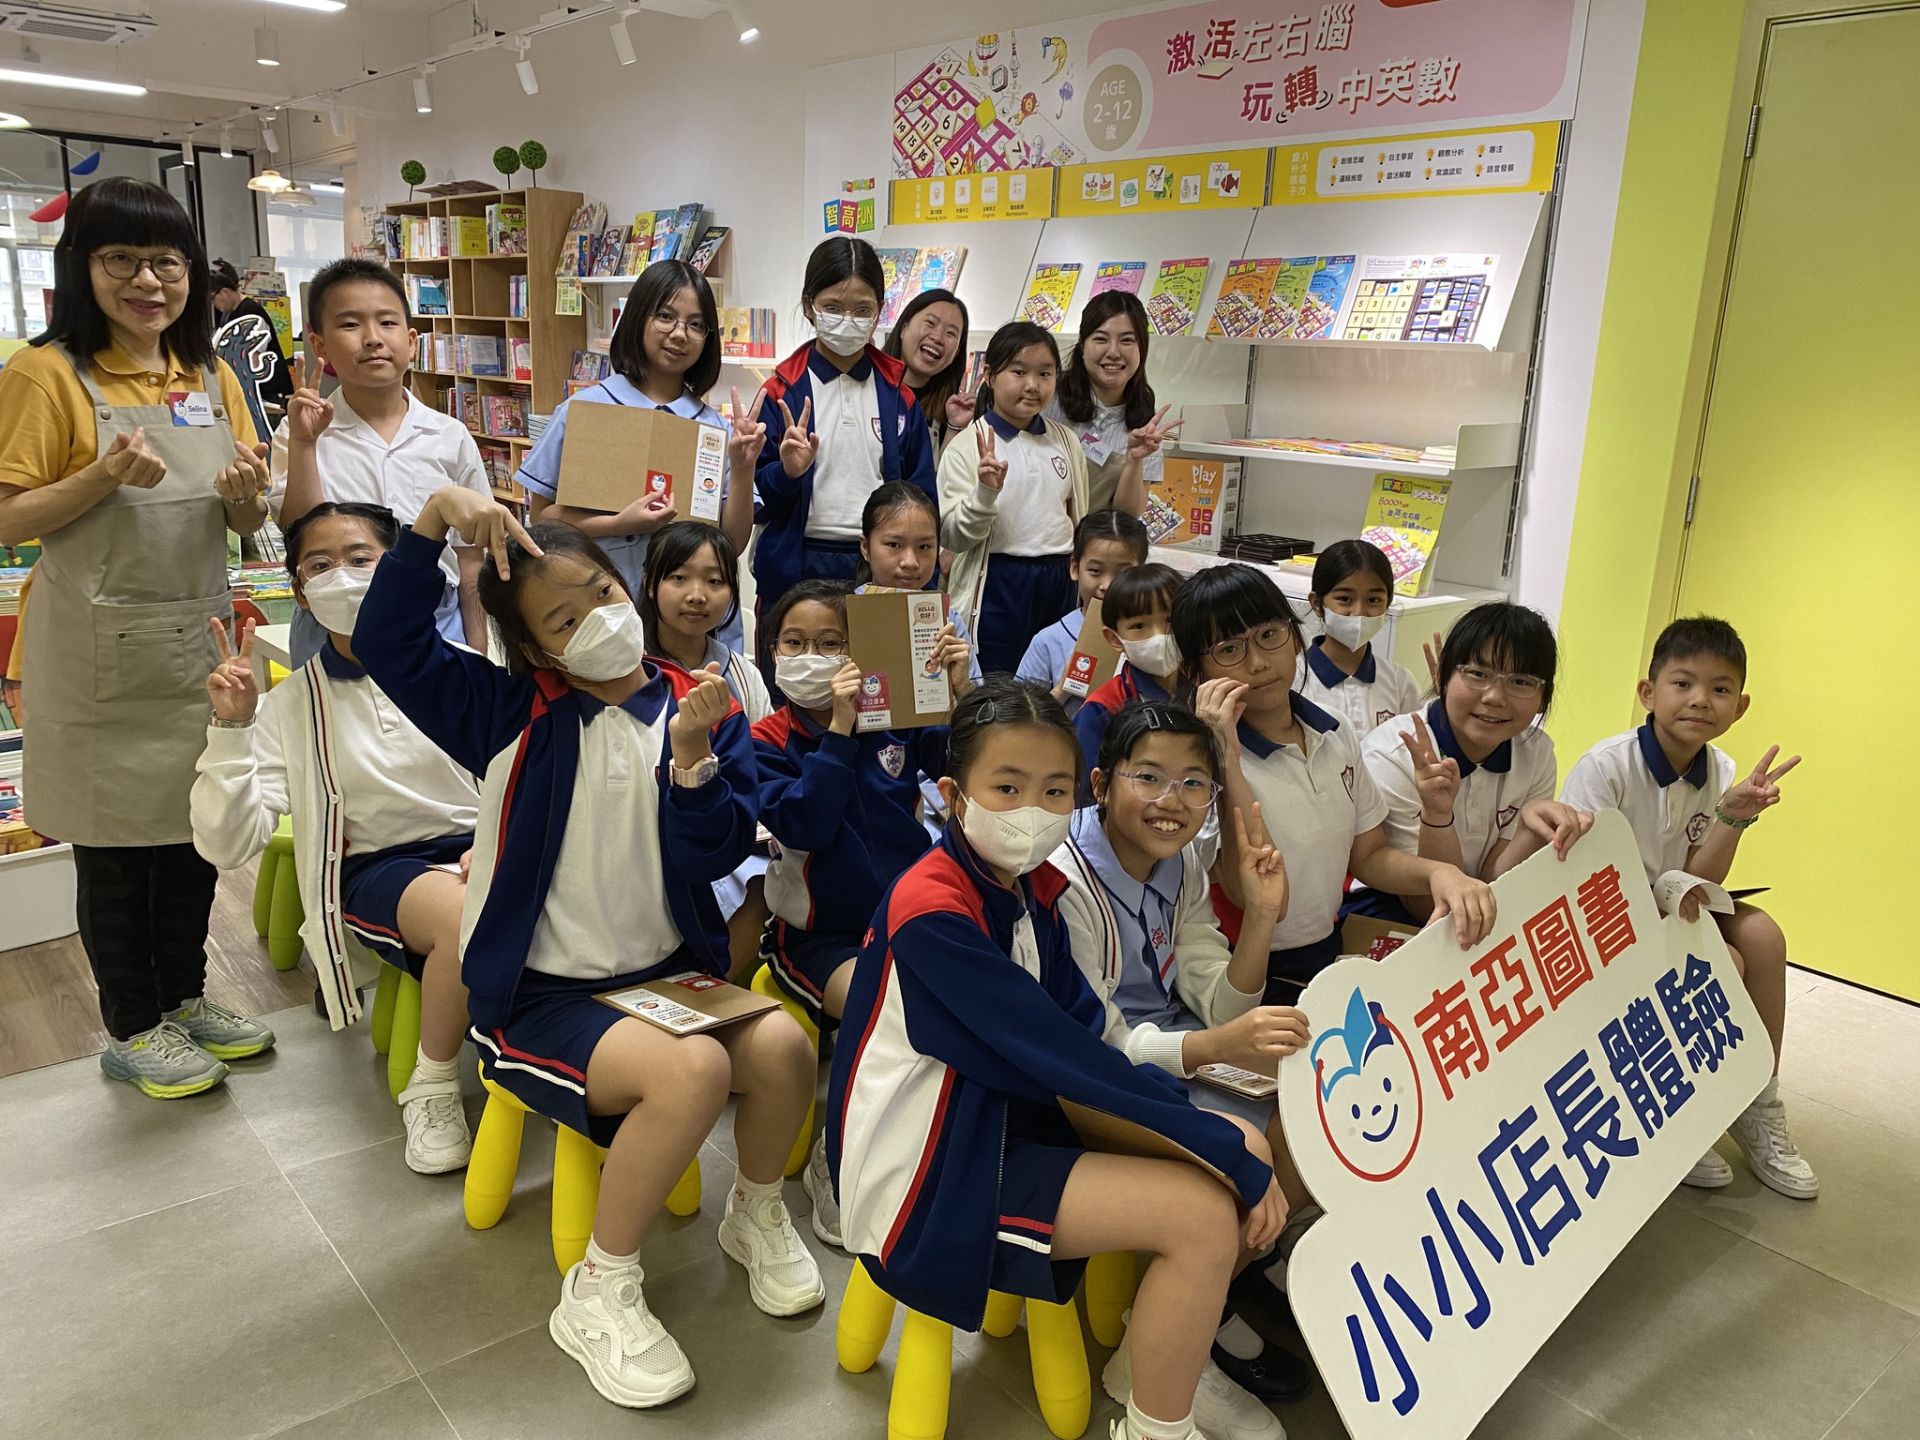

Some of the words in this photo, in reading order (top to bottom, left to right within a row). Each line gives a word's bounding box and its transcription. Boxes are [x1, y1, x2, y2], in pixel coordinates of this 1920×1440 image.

[1166, 3, 1355, 75] 激活左右腦
[1100, 80, 1126, 97] AGE
[1240, 56, 1462, 123] 玩轉中英數
[1093, 99, 1132, 123] 2-12
[896, 121, 906, 133] 14
[921, 119, 930, 132] 11
[942, 115, 951, 130] 6
[907, 134, 918, 147] 15
[932, 136, 941, 147] 12
[918, 148, 928, 162] 16
[1012, 144, 1022, 154] 7
[950, 157, 959, 170] 2
[187, 405, 207, 413] Selina
[1192, 464, 1217, 485] Play
[1414, 864, 1638, 1100] 南亞圖書
[1345, 953, 1745, 1416] 小小店長體驗
